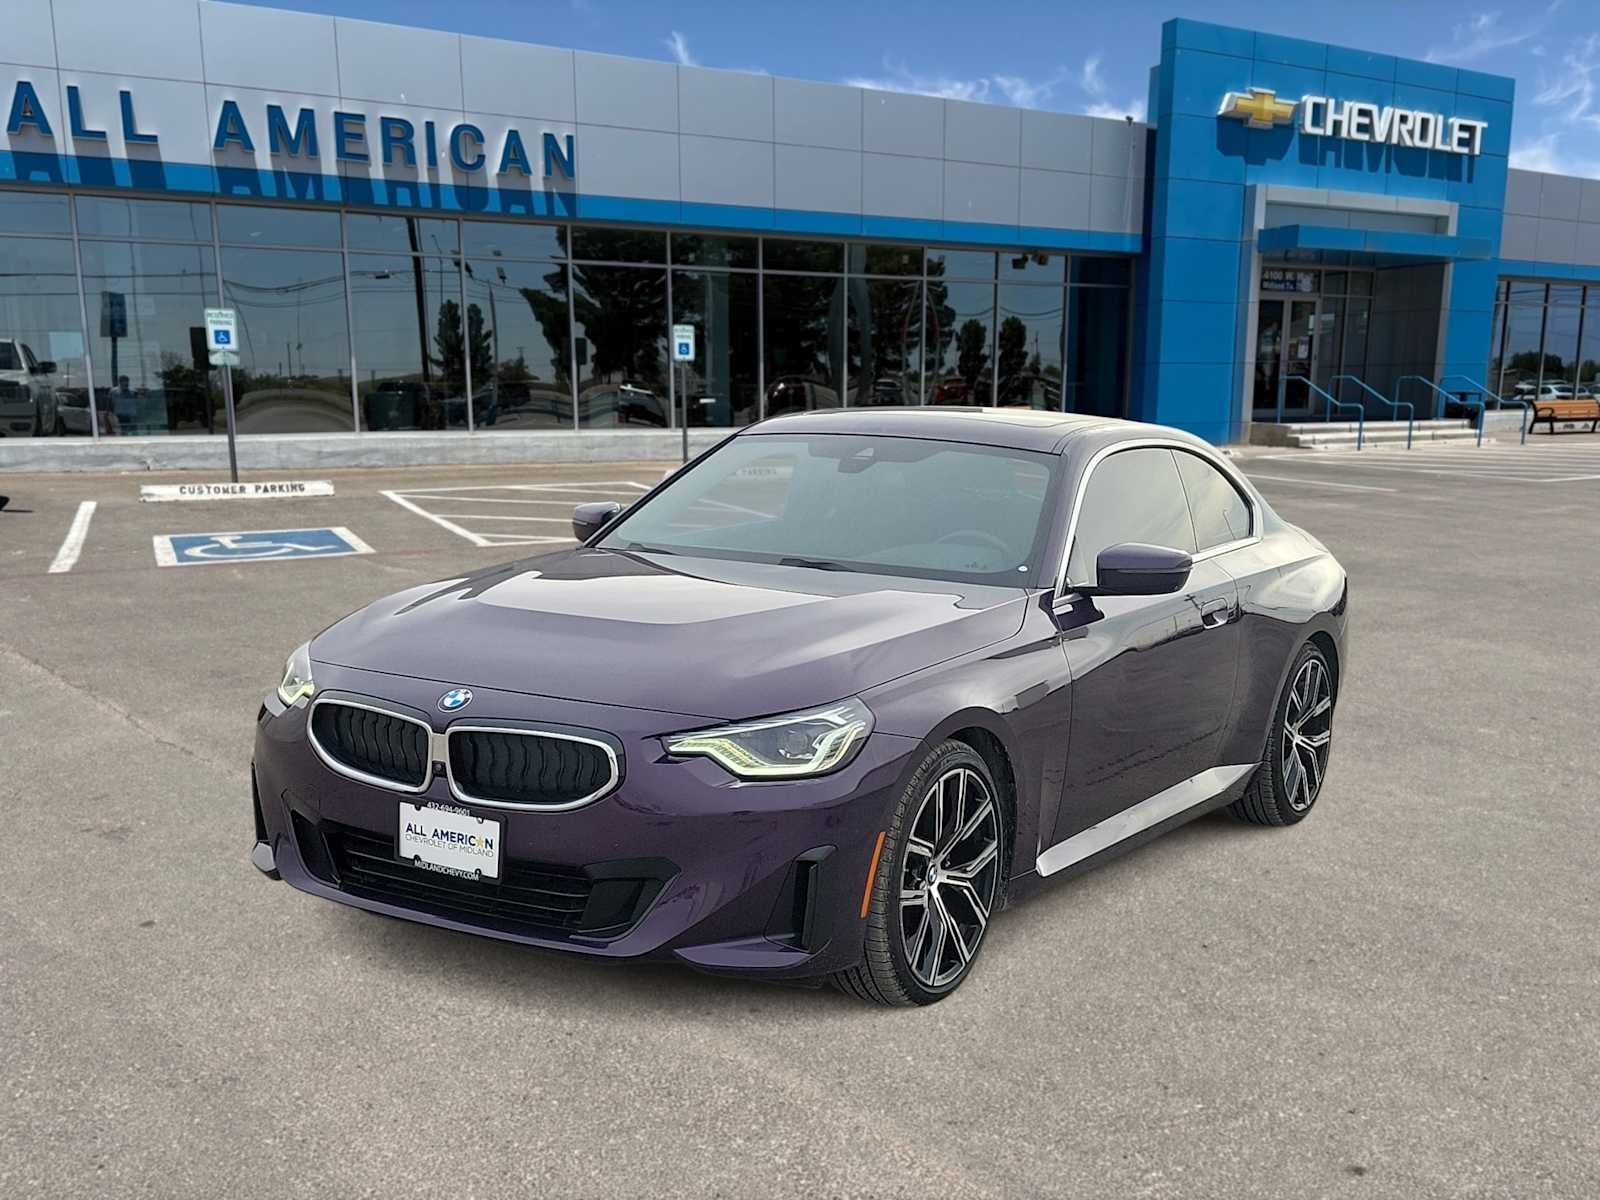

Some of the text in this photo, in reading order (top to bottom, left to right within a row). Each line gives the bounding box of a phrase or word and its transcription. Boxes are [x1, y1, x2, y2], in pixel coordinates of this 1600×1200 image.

[7, 81, 575, 179] ALL AMERICAN
[1301, 94, 1488, 155] CHEVROLET
[179, 483, 305, 495] CUSTOMER PARKING
[405, 822, 427, 837] ALL
[405, 834, 446, 849] CHEVROLET
[460, 846, 494, 858] MIDLAND
[414, 860, 479, 880] MIDLANDCHEVY.COM
